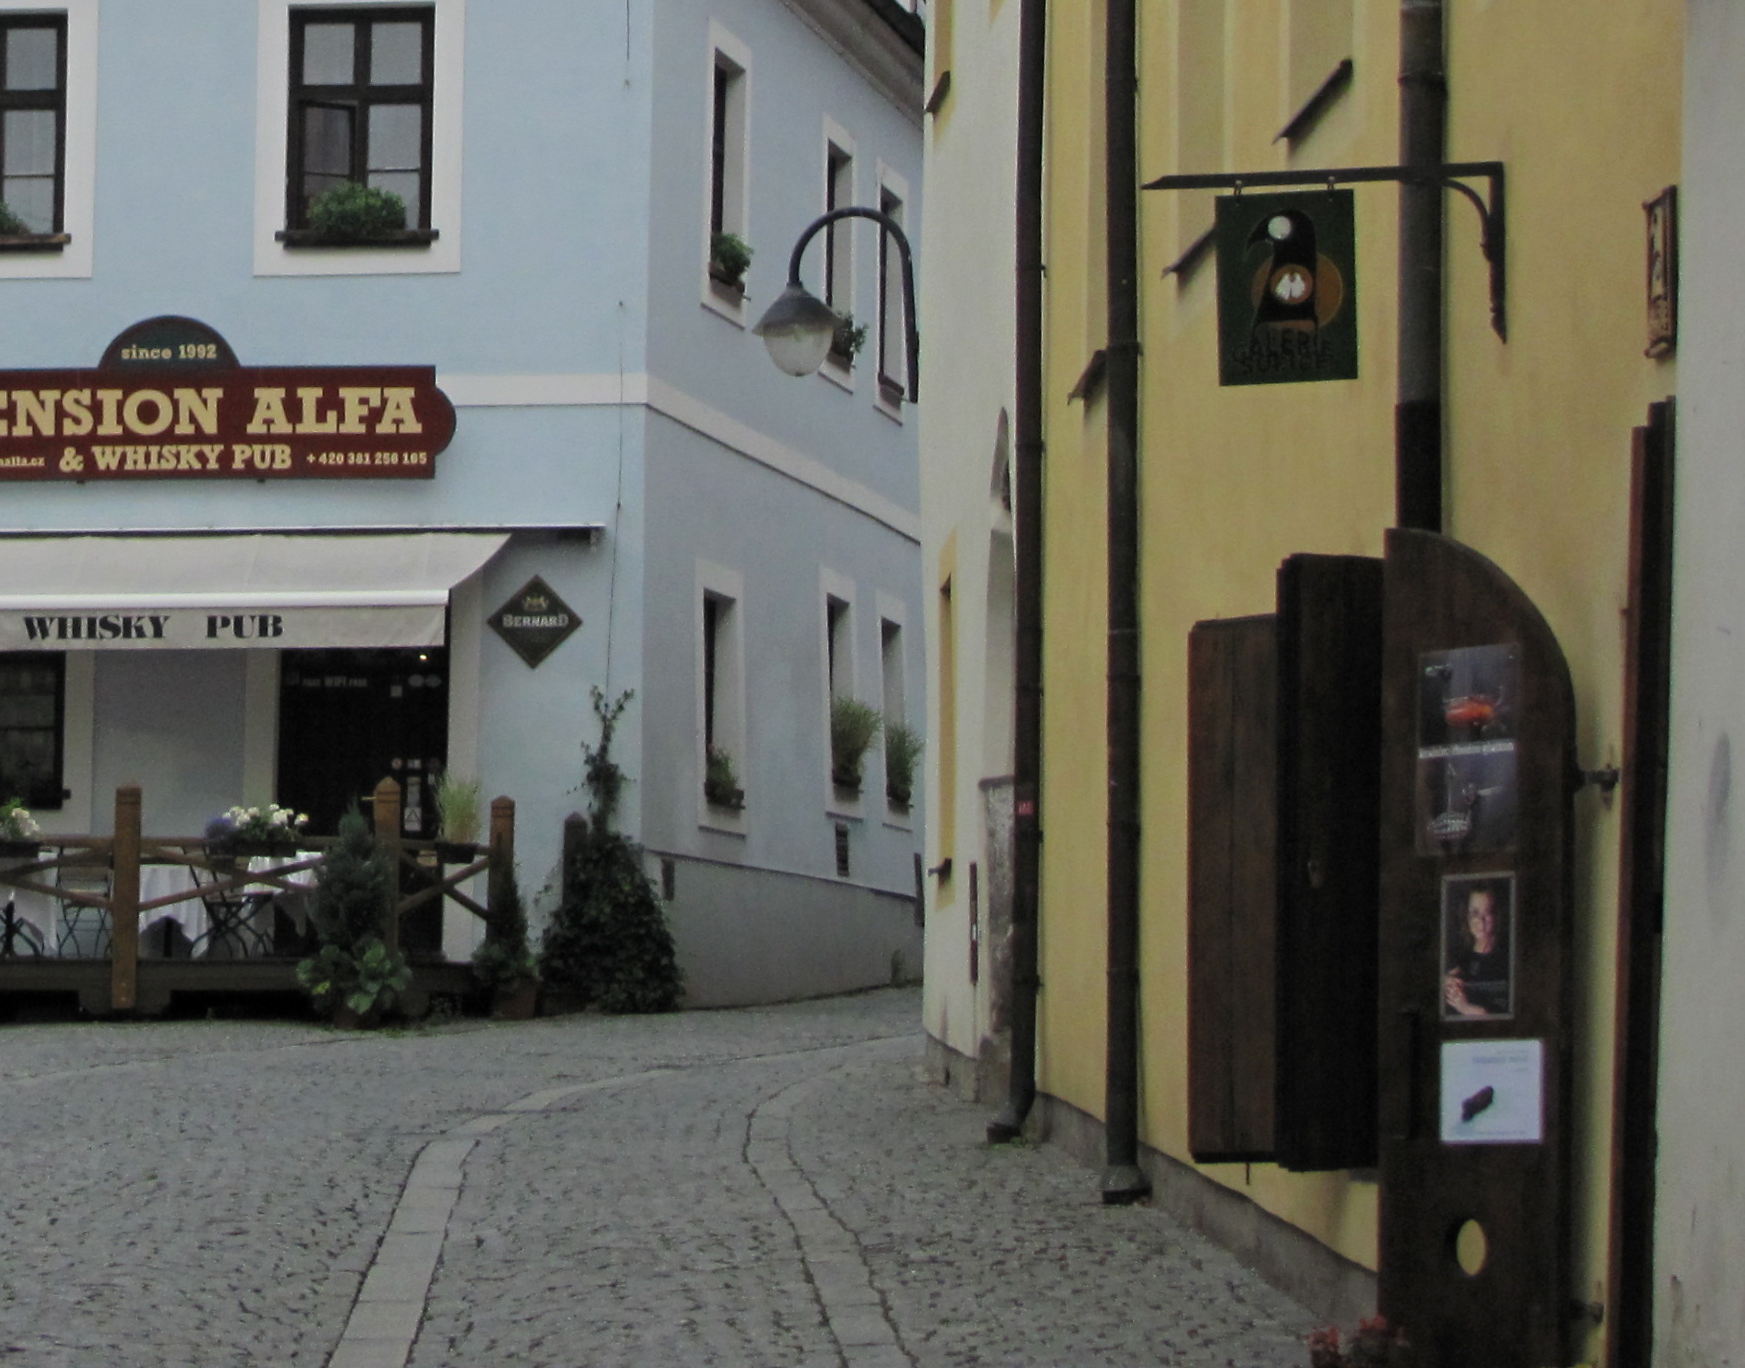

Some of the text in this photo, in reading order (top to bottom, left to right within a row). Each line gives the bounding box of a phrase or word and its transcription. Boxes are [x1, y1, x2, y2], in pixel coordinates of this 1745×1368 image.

[121, 343, 217, 360] since 1992
[246, 387, 423, 435] ALFA
[59, 446, 85, 473] &
[91, 444, 224, 472] WHISKY
[231, 444, 292, 470] PUB
[347, 451, 371, 465] 381
[23, 614, 285, 641] WHISKY PUB
[502, 613, 569, 628] BERNARD
